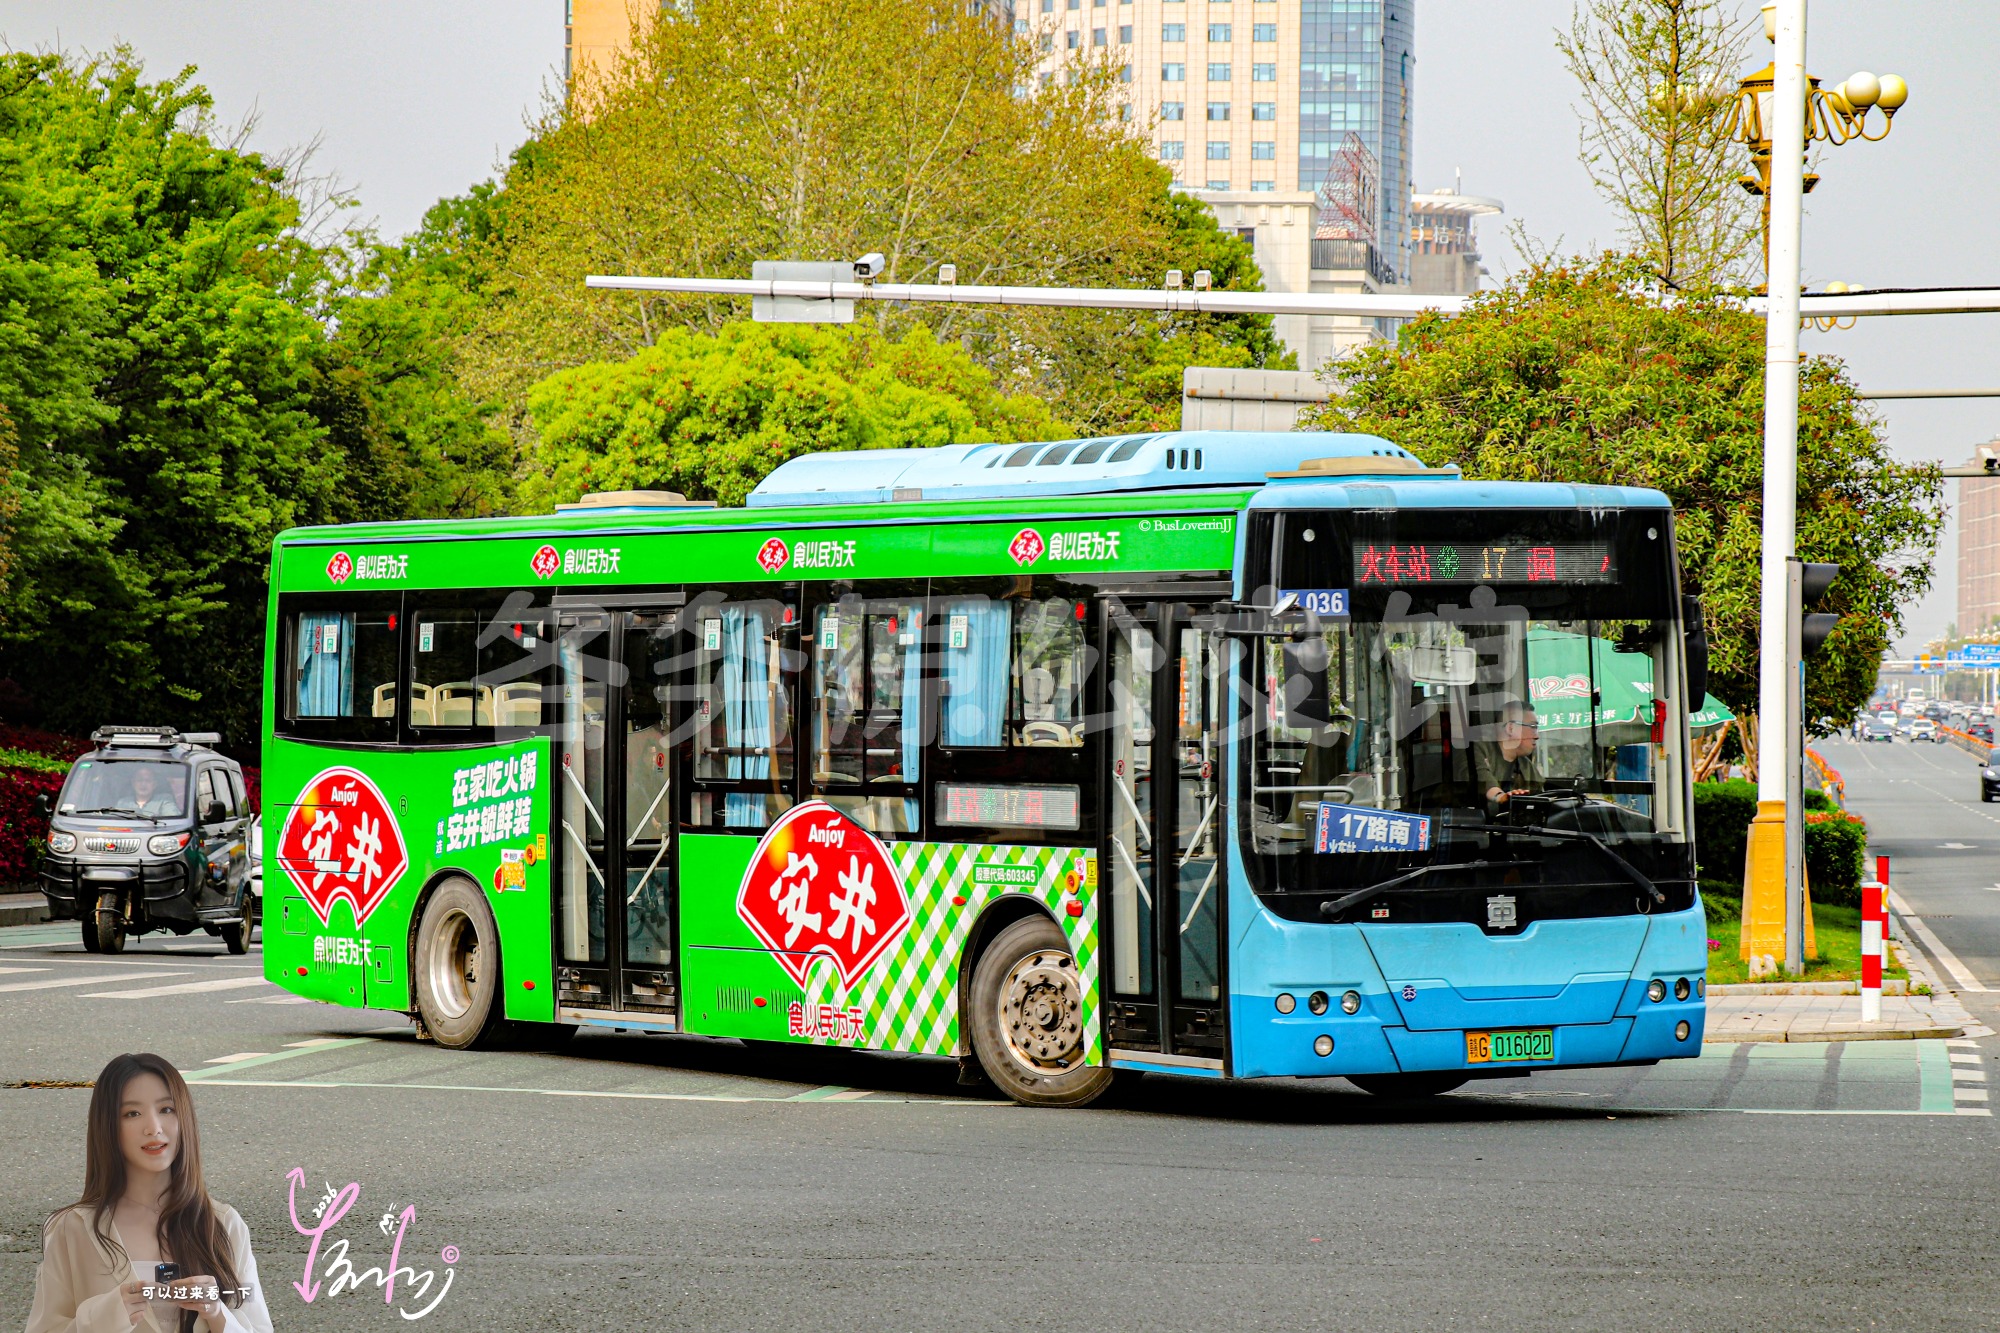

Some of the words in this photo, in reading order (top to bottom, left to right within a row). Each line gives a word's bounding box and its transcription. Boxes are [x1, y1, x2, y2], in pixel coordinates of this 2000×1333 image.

[1434, 225, 1465, 244] 桔子
[563, 548, 621, 574] 食以民为天
[793, 540, 857, 568] 食以民为天
[1048, 531, 1120, 561] 食以民为天
[355, 554, 409, 580] 食以民为天
[1361, 545, 1431, 582] 火车站
[1482, 548, 1507, 578] 17
[331, 781, 359, 807] Anjoy
[452, 751, 537, 807] 在家吃火锅
[1003, 790, 1020, 821] 17
[446, 796, 532, 852] 安井锁鲜装
[808, 817, 846, 848] Anjoy
[1339, 813, 1411, 846] 17路南
[302, 810, 382, 894] 安井
[770, 852, 876, 954] 安井
[313, 935, 372, 966] 食以民为天
[788, 1002, 866, 1042] 食以民为天
